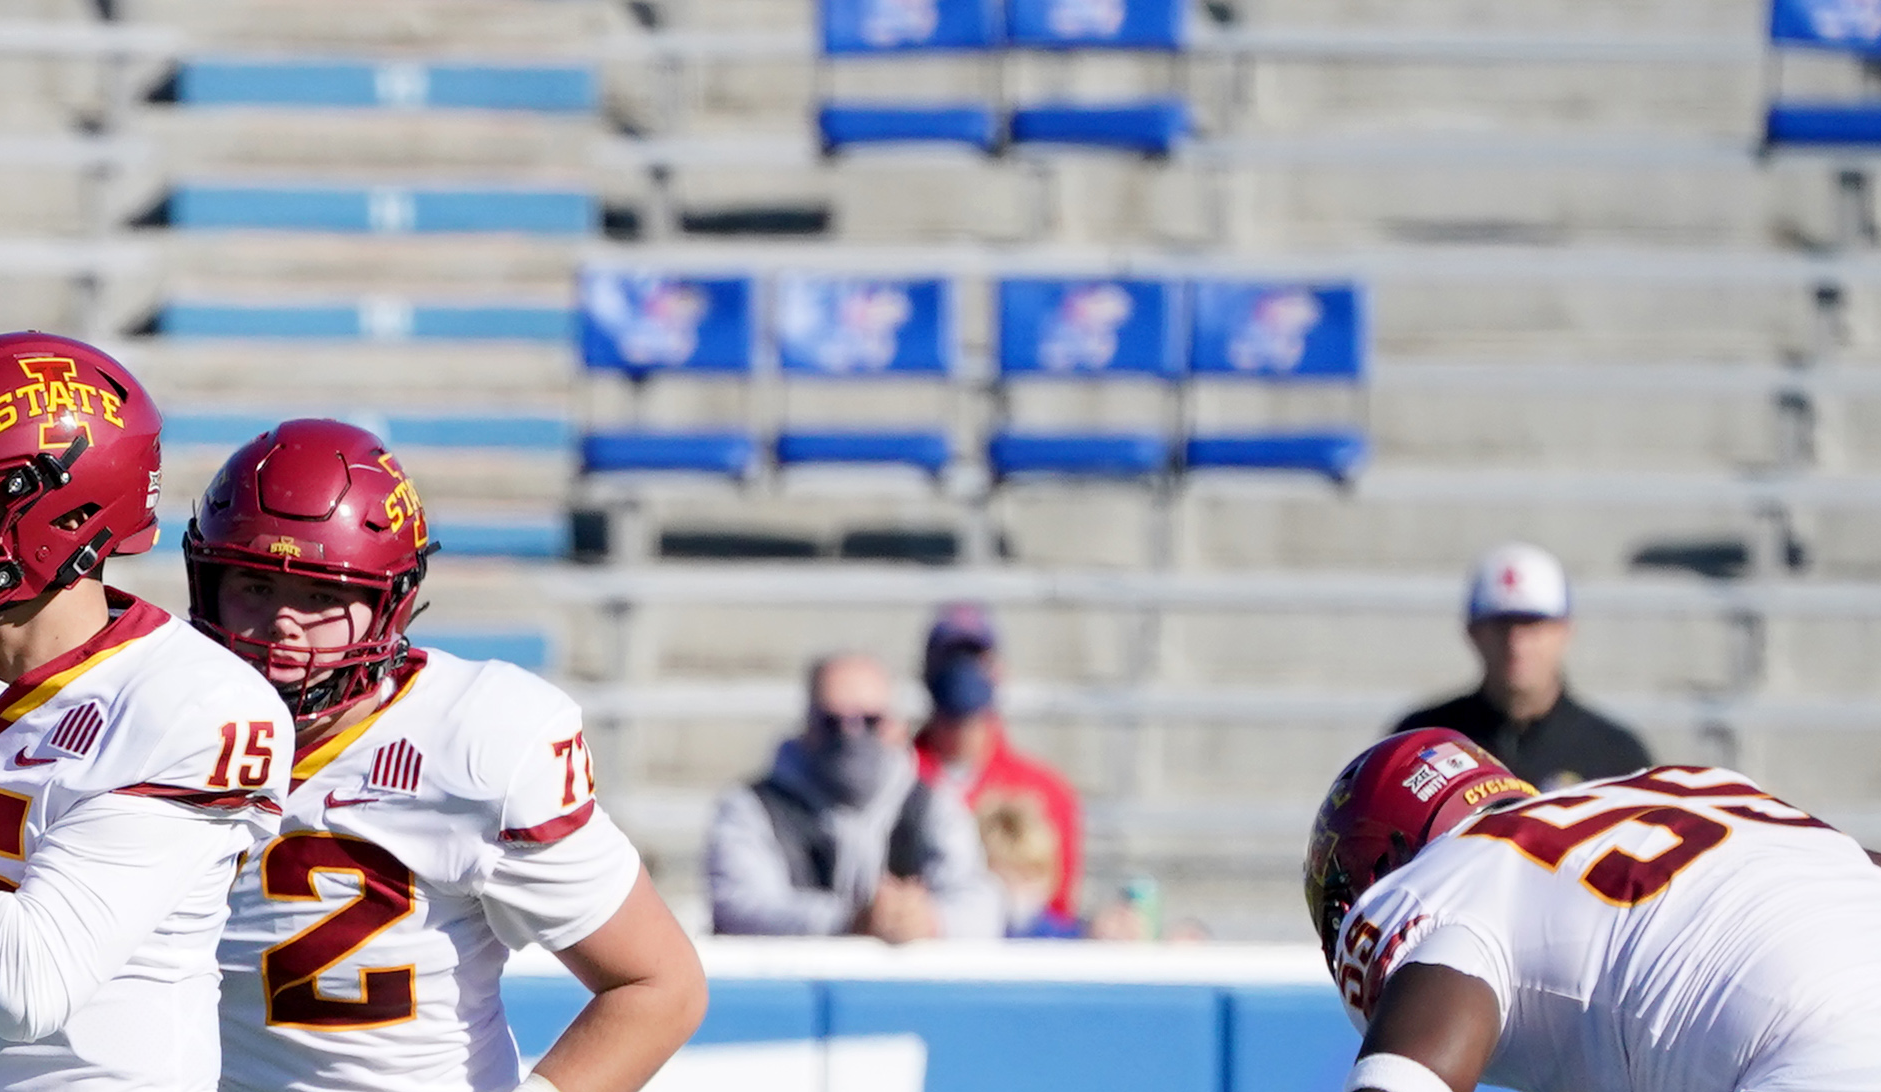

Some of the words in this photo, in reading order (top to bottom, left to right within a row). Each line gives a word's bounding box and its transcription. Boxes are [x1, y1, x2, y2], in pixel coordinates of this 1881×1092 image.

[205, 720, 274, 788] 15
[1416, 773, 1448, 803] UNITY
[1457, 764, 1849, 909] 55
